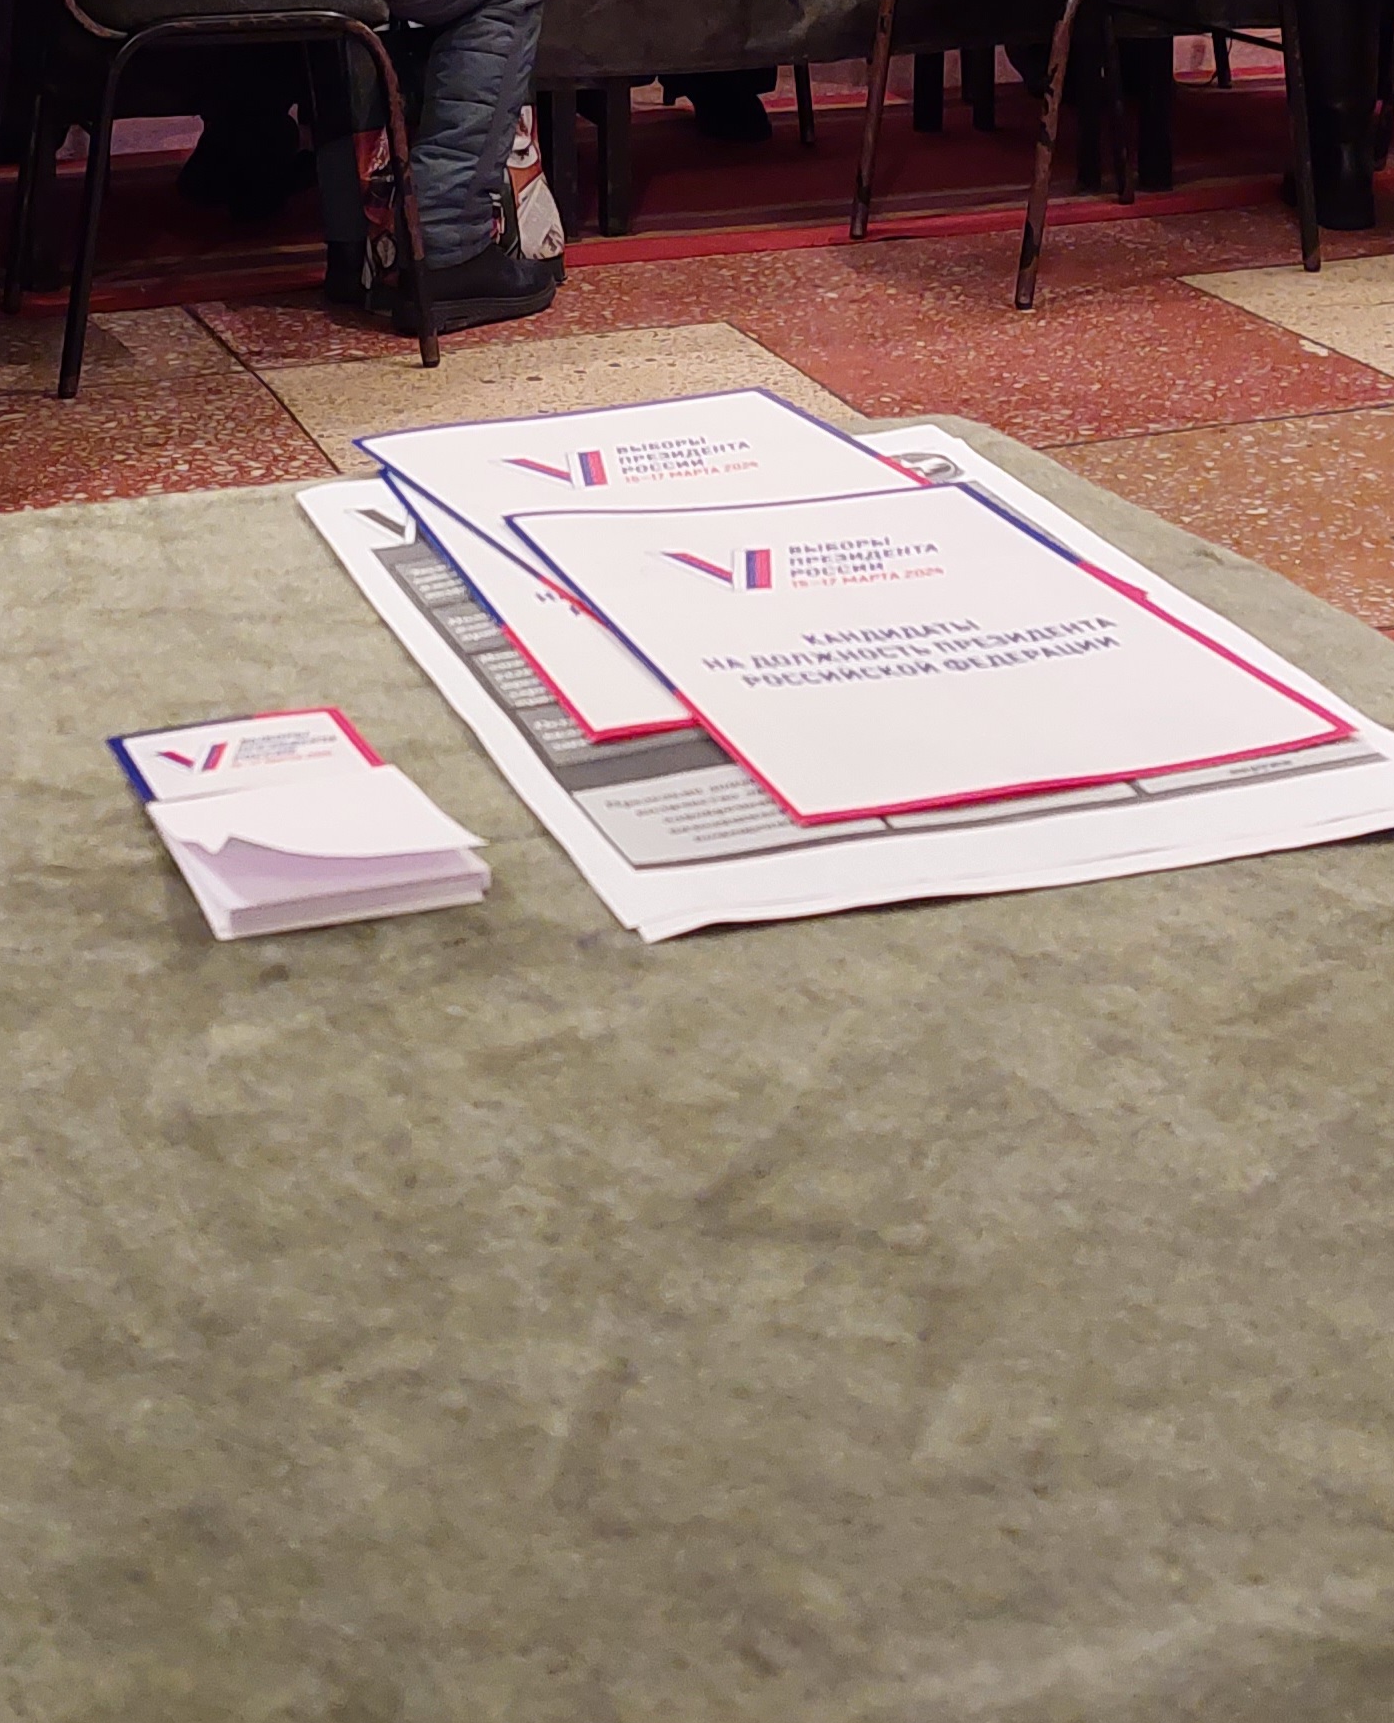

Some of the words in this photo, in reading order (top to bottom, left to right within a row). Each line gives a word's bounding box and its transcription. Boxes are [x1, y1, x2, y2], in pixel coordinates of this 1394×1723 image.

[616, 436, 707, 455] ВЫБОРЫ
[617, 440, 751, 464] ПРЕЗИДЕНТА
[621, 458, 705, 475] РОССИИ
[788, 536, 891, 554] ВЫБОРЫ
[789, 542, 938, 566] ПРЕЗИДЕНТА
[790, 562, 884, 578] РОССИИ
[702, 656, 744, 670] НА
[751, 644, 931, 669] ДОЛЖНОСТЬ
[933, 617, 1118, 653] ПРЕЗИДЕНТА
[802, 618, 981, 645] КАНДИДАТЫ
[742, 661, 940, 687] РОССИЙСКОЙ
[943, 635, 1120, 671] ФЕДЕРАЦИИ
